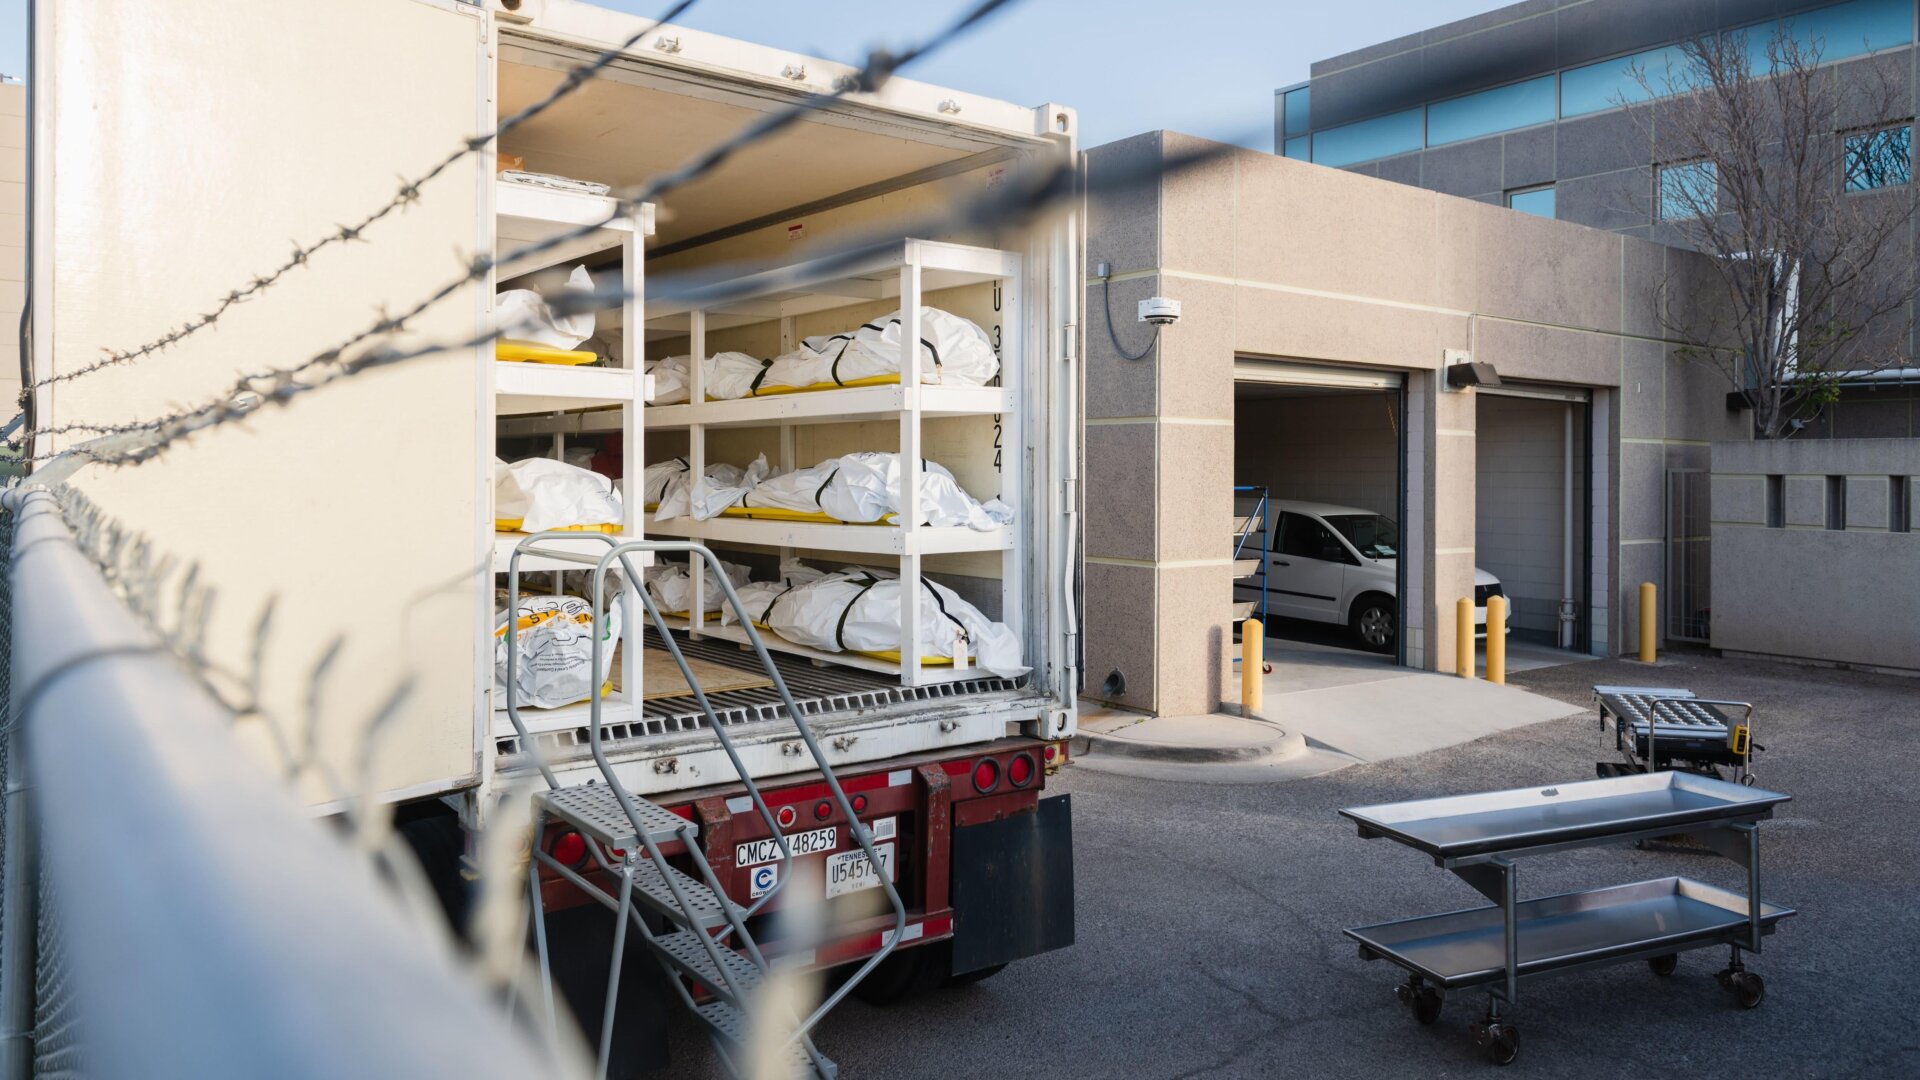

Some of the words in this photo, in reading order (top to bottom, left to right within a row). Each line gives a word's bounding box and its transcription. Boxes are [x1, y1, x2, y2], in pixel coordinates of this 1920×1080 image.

[737, 840, 777, 866] CMCZ
[786, 828, 836, 855] 148259
[841, 848, 878, 863] TENNESE
